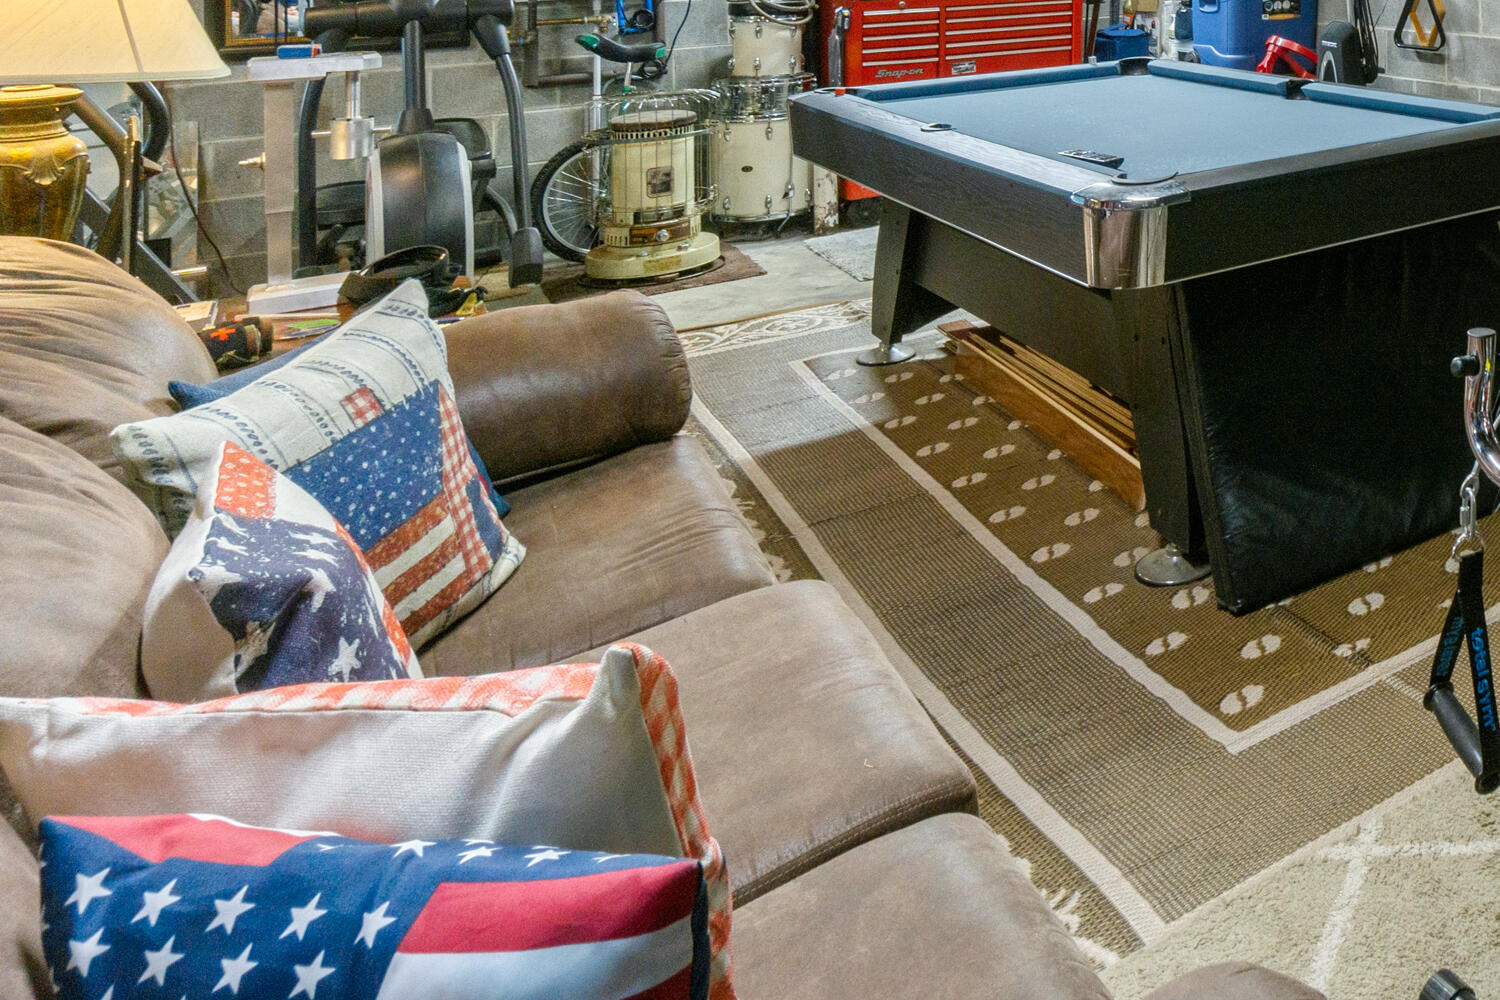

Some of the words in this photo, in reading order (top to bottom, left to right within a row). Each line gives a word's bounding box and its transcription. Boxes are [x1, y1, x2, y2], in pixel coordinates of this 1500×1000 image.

[875, 67, 924, 79] Snap-on
[1470, 627, 1489, 676] total
[1477, 679, 1495, 727] gym
